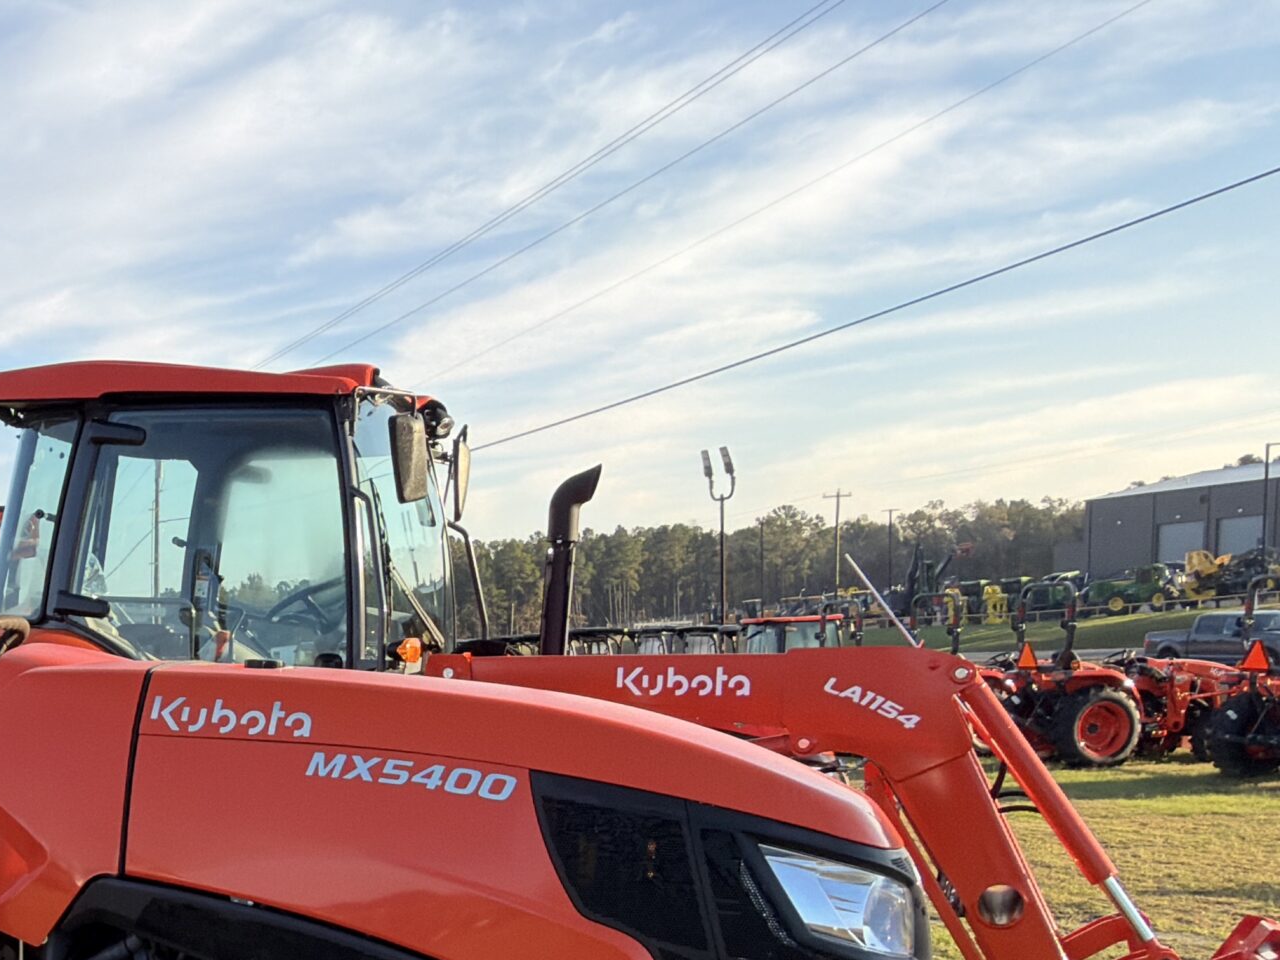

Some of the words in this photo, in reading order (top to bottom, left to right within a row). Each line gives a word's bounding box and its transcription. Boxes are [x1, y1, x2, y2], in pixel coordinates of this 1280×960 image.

[616, 666, 751, 696] Kubota
[823, 677, 921, 729] LA1154
[150, 695, 312, 738] Kubota
[305, 751, 518, 801] MX5400
